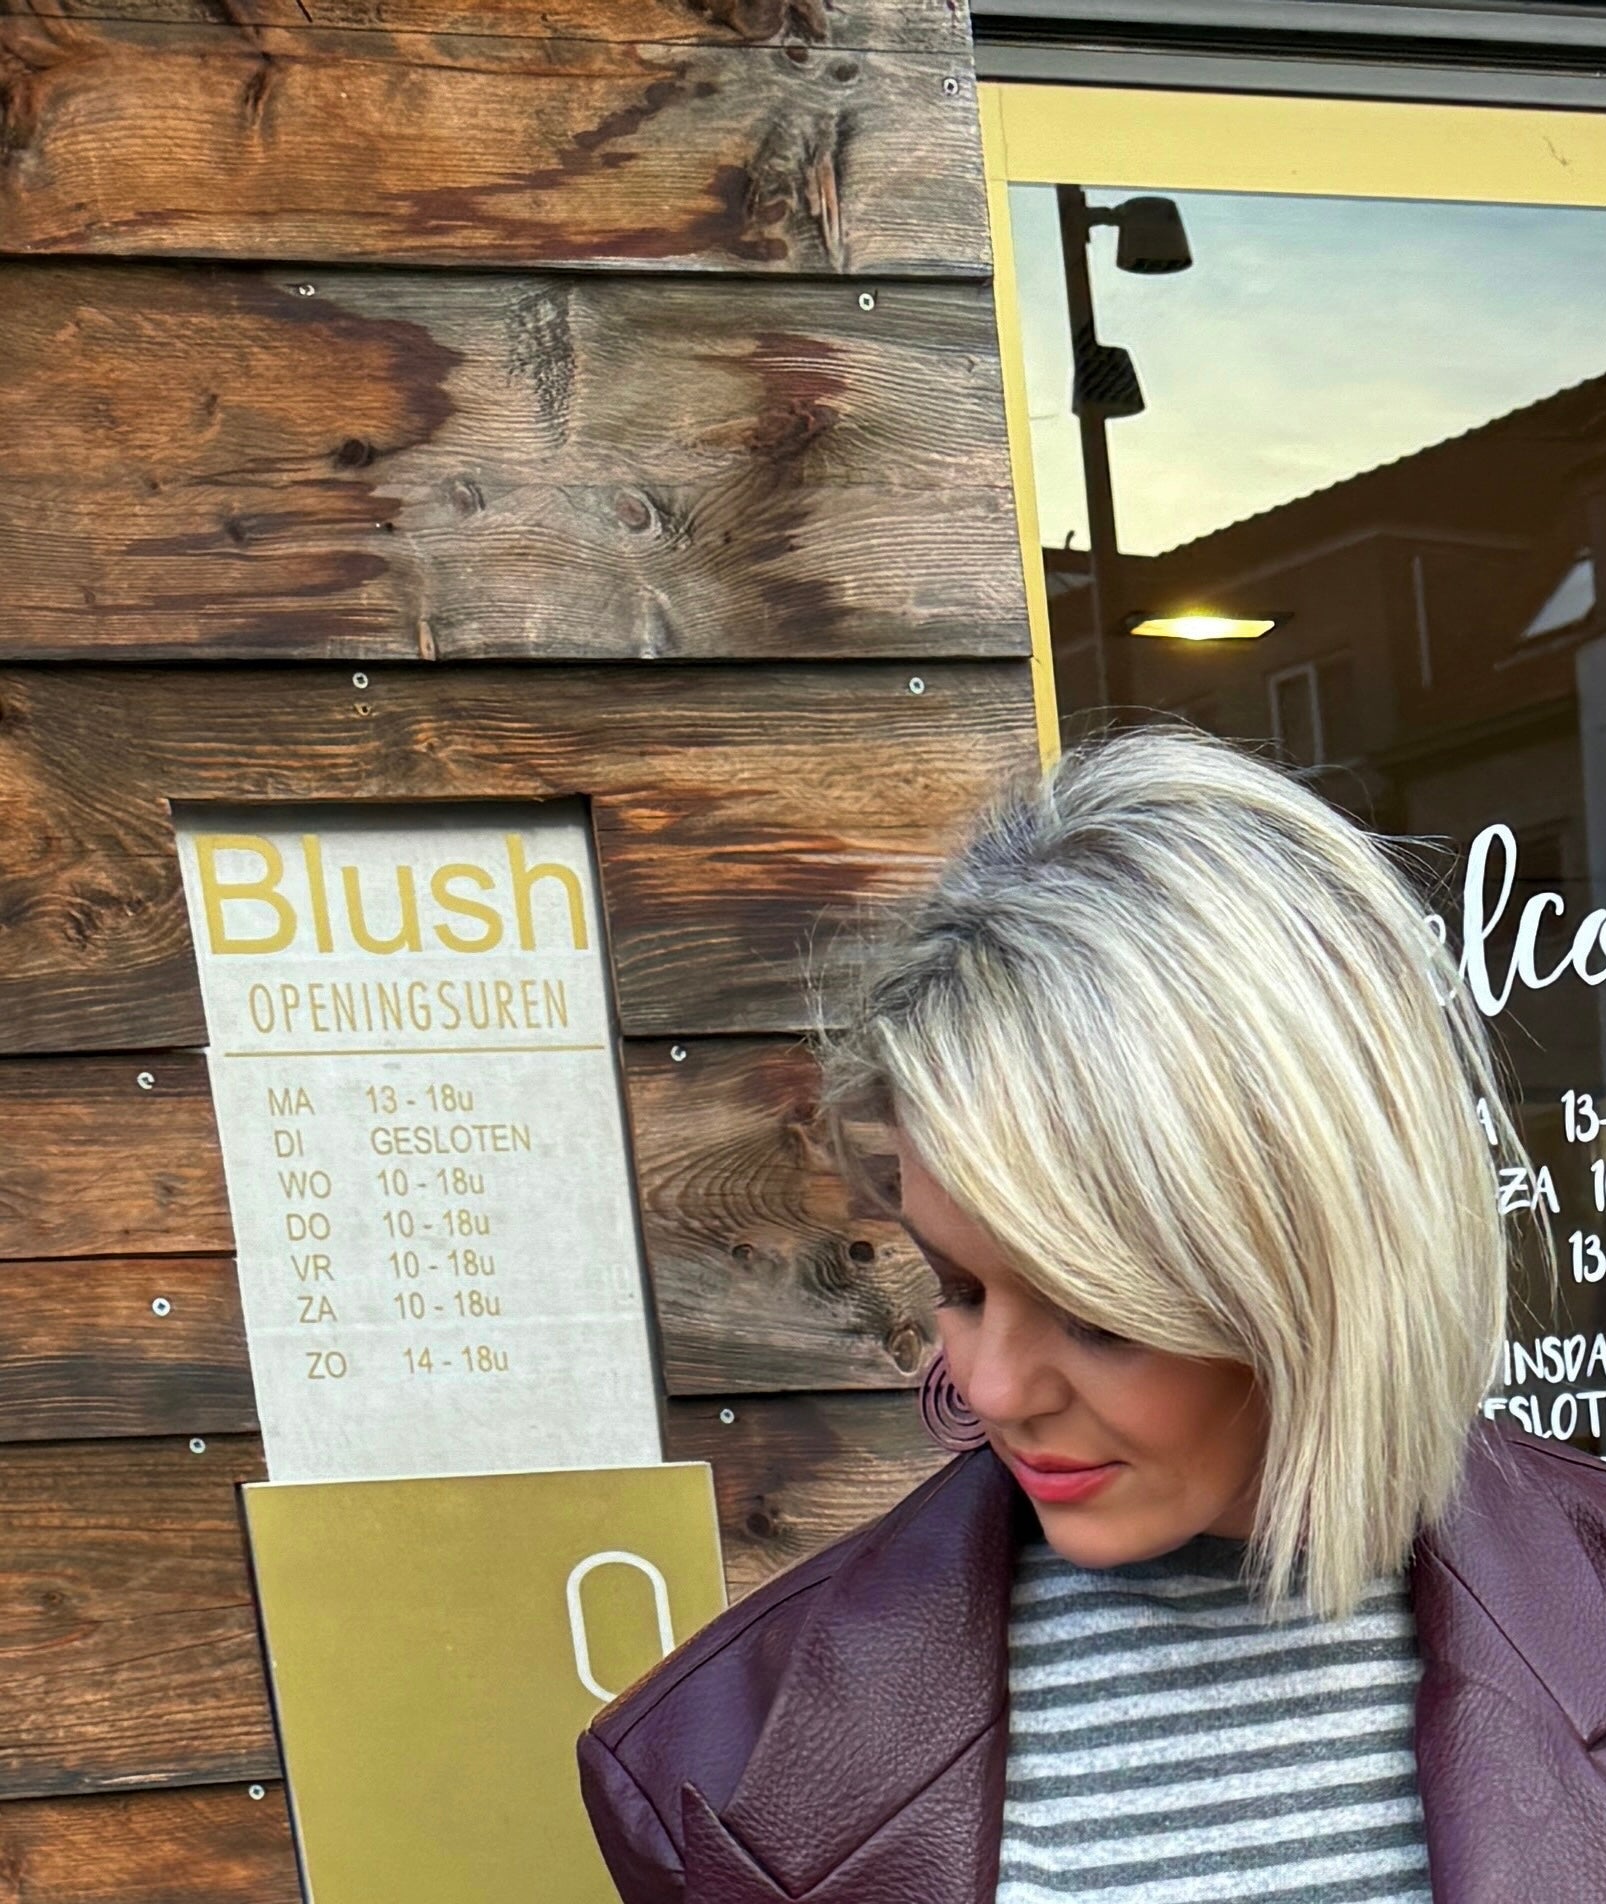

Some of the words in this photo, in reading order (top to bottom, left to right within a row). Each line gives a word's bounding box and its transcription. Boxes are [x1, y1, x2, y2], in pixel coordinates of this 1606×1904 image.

[194, 833, 589, 955] Blush
[248, 980, 570, 1034] OPENINGSUREN
[267, 1086, 316, 1117] MA
[366, 1085, 398, 1115] 13
[425, 1083, 475, 1112] 18u
[273, 1129, 305, 1158] DI
[370, 1124, 532, 1155] GESLOTEN
[278, 1170, 333, 1200] WO
[377, 1168, 409, 1197] 10
[436, 1167, 485, 1196] 18u
[286, 1212, 332, 1241] DO
[383, 1209, 415, 1238] 10
[442, 1208, 491, 1237] 18u
[290, 1254, 335, 1282] VR
[389, 1250, 420, 1279] 10
[448, 1249, 496, 1277] 18u
[297, 1295, 338, 1324] ZA
[394, 1291, 426, 1320] 10
[454, 1289, 502, 1318] 18u
[306, 1350, 348, 1380] ZO
[403, 1347, 434, 1374] 14
[461, 1345, 510, 1373] 18u
